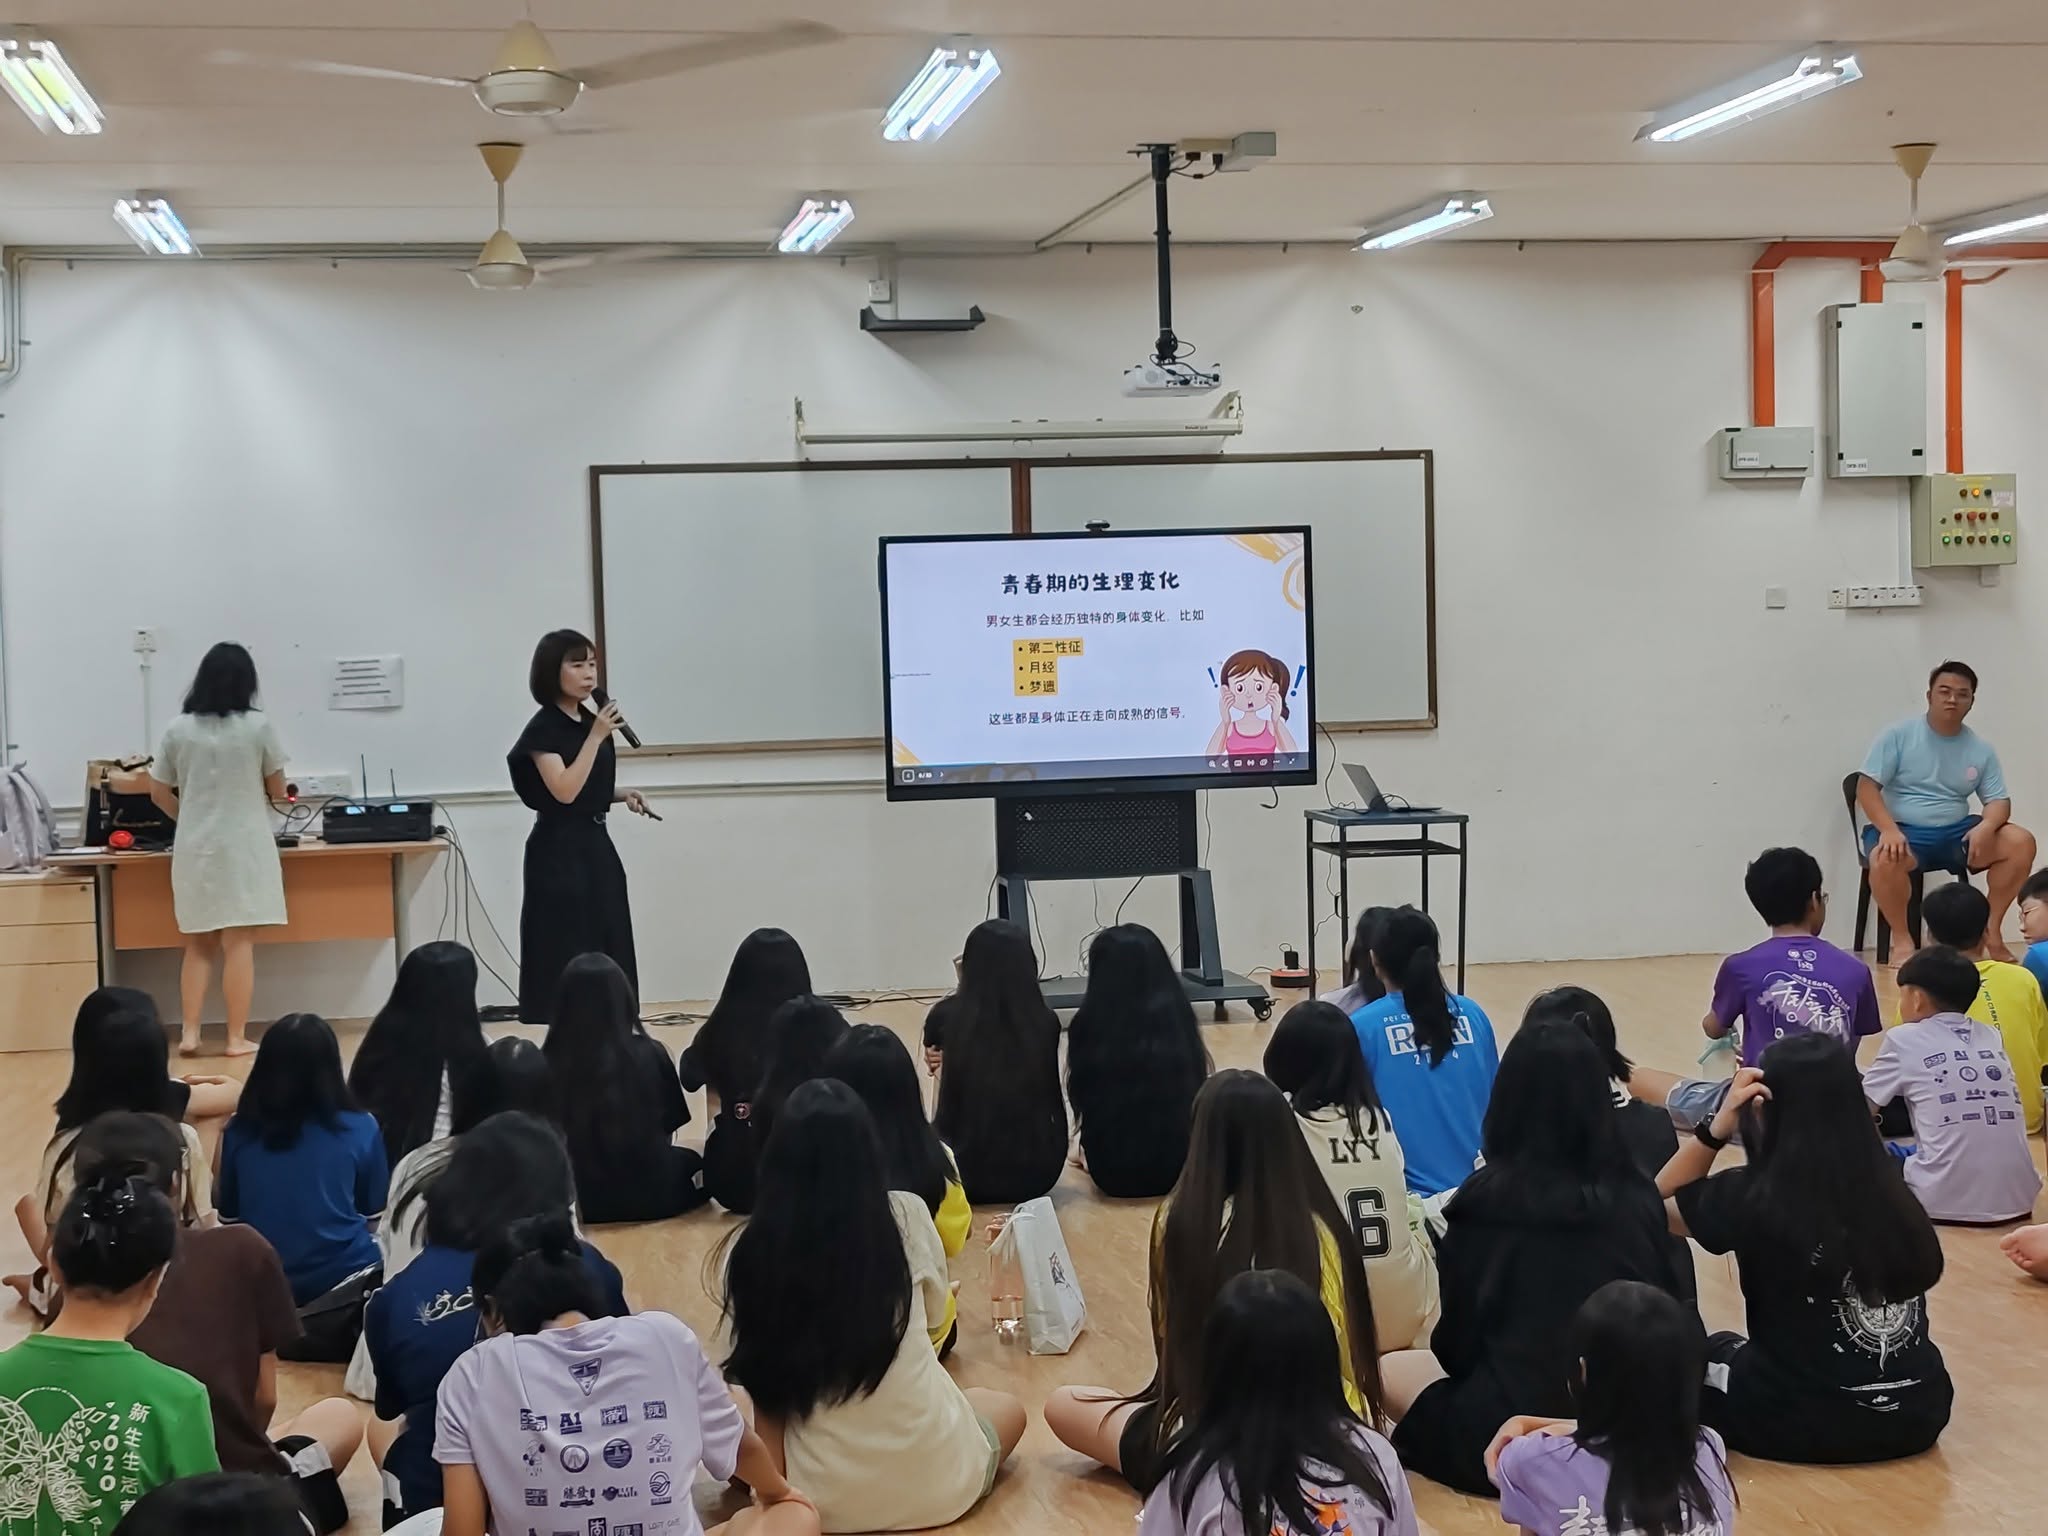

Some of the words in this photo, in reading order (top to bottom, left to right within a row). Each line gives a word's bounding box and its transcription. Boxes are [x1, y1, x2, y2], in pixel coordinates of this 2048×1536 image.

[1001, 571, 1181, 595] 青春期的生理变化
[1028, 640, 1081, 655] 第二性征
[1029, 661, 1055, 674] 月经
[1029, 680, 1056, 694] 梦遗
[1328, 1137, 1381, 1164] LYY
[1345, 1186, 1392, 1259] 6
[559, 1411, 582, 1427] A1
[100, 1413, 120, 1493] 2020
